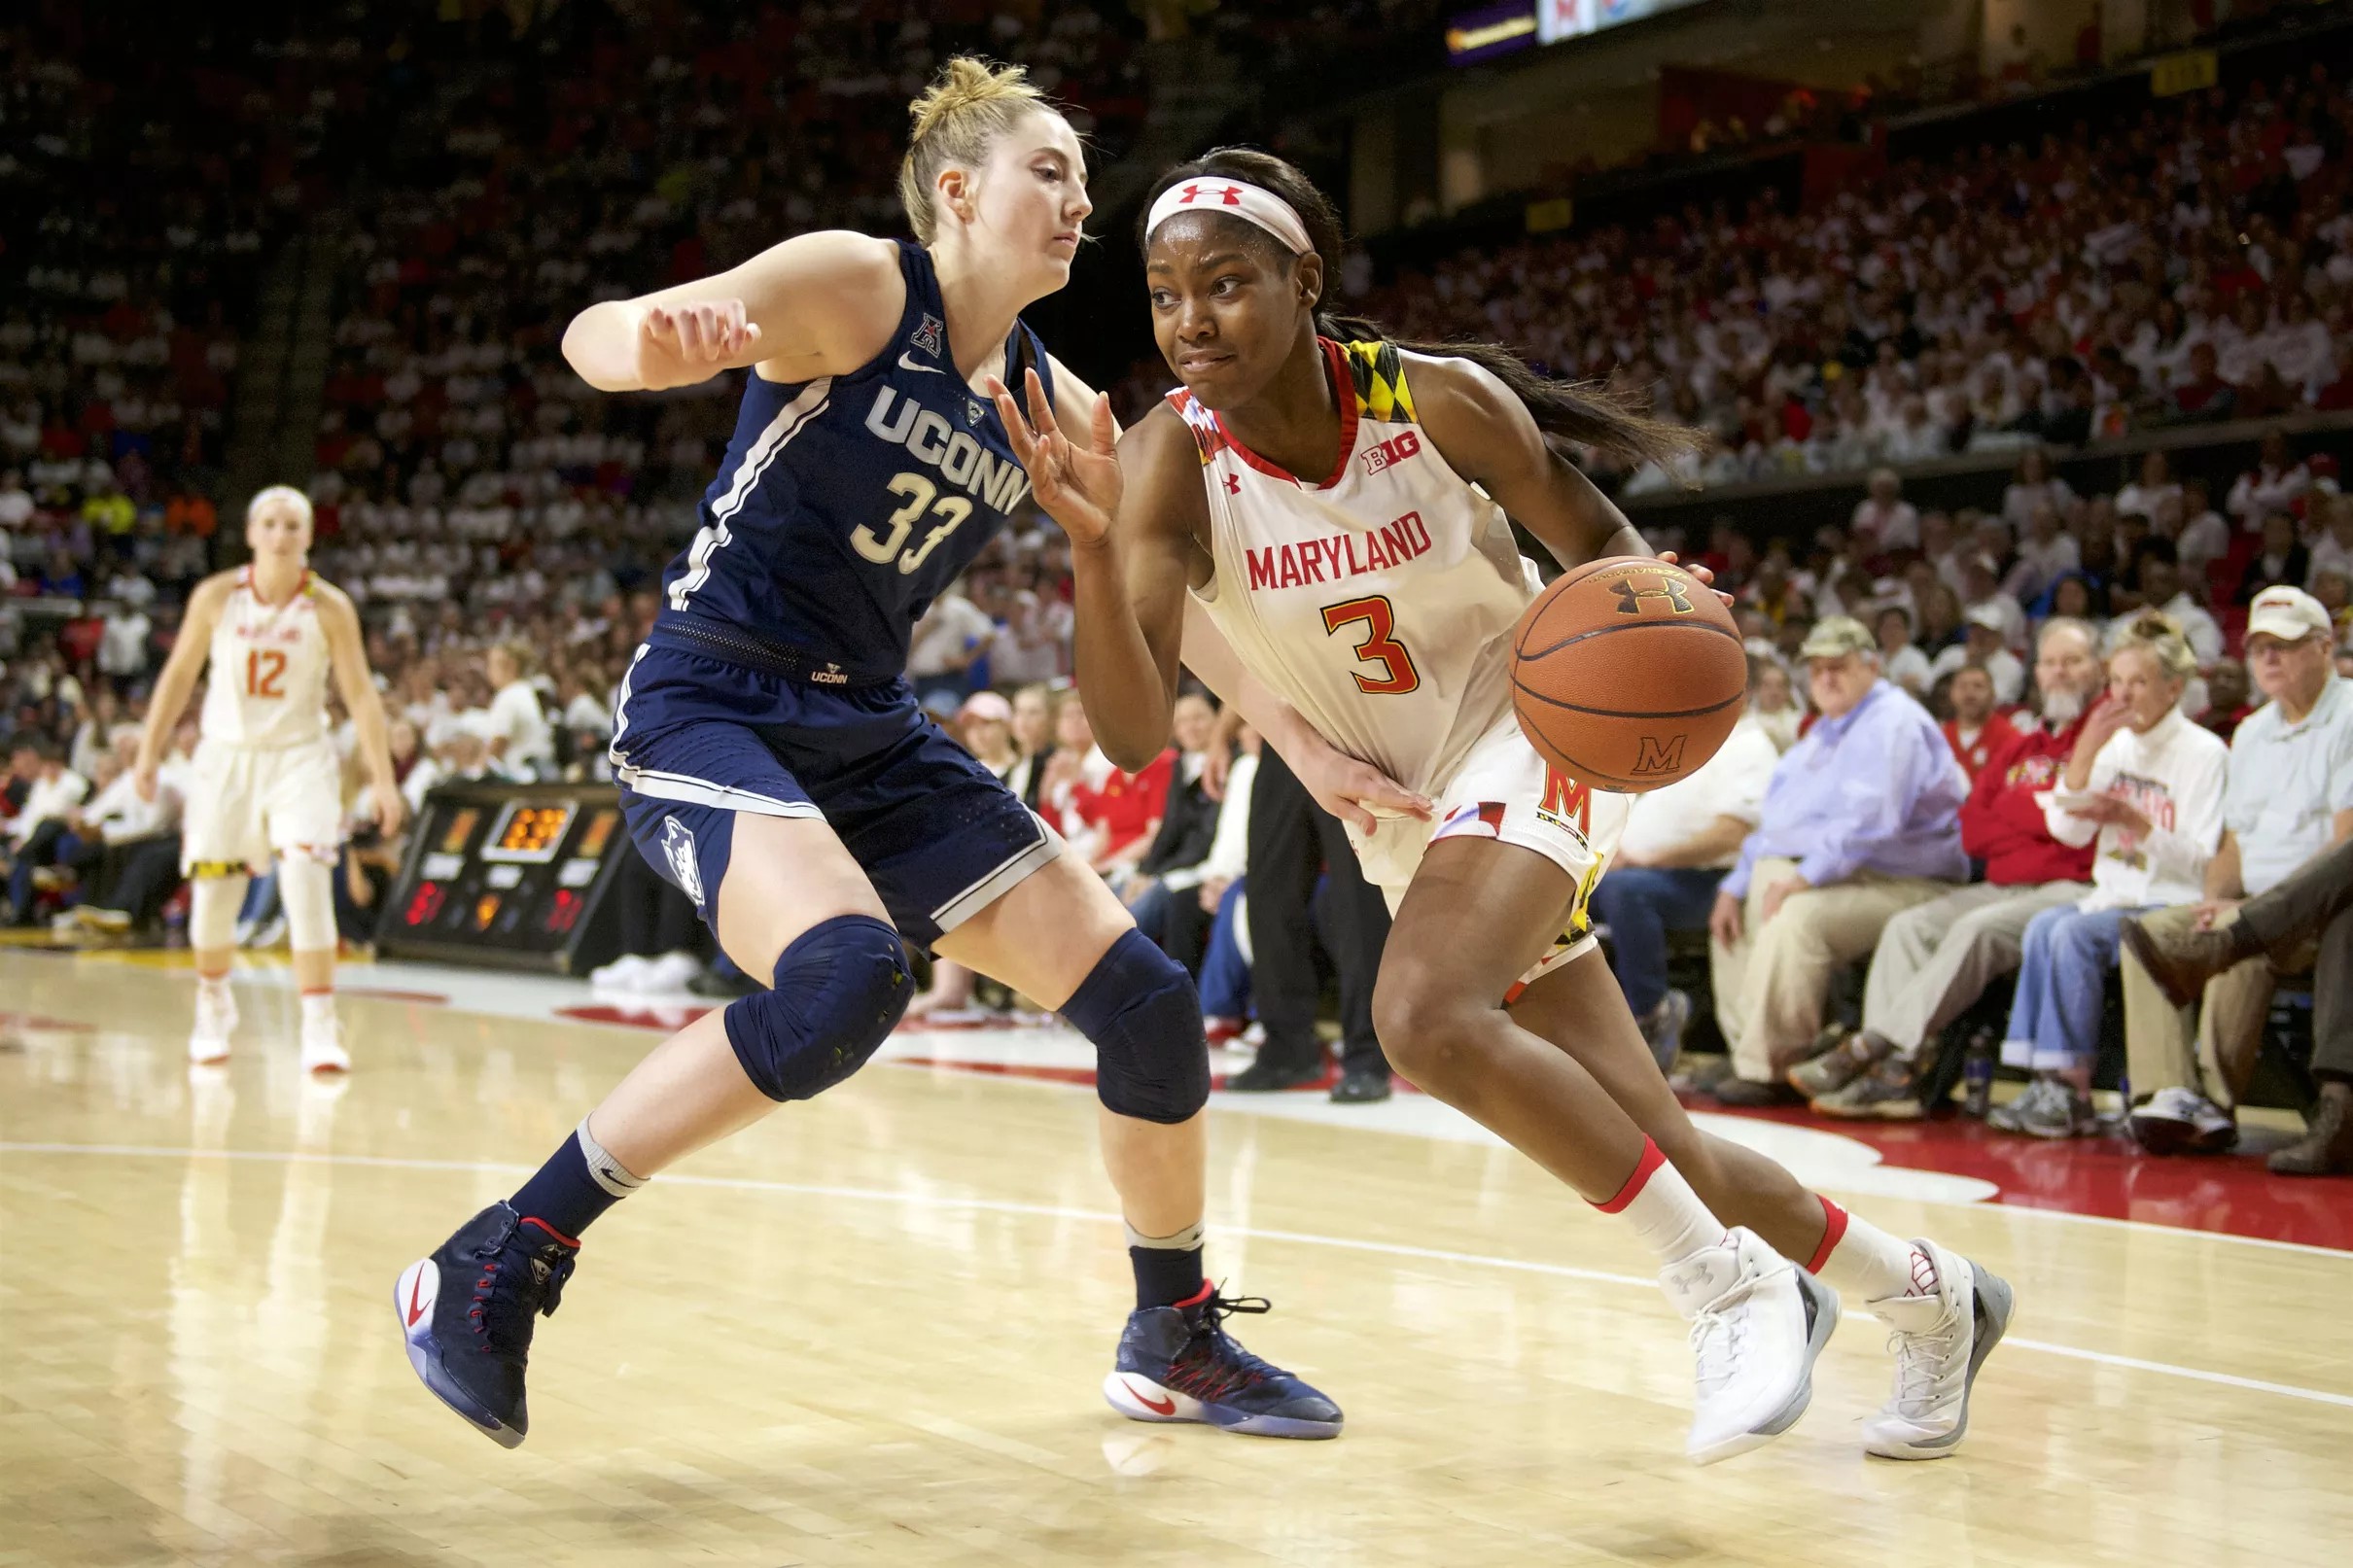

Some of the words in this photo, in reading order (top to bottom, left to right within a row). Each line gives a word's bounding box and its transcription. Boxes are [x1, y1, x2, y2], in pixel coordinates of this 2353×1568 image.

[864, 385, 1032, 516] UCONN
[850, 471, 973, 575] 33
[1246, 510, 1432, 591] MARYLAND
[247, 649, 287, 698] 12
[811, 671, 848, 684] UCONN
[1319, 594, 1421, 695] 3
[1632, 734, 1689, 776] M
[1538, 762, 1593, 841] M
